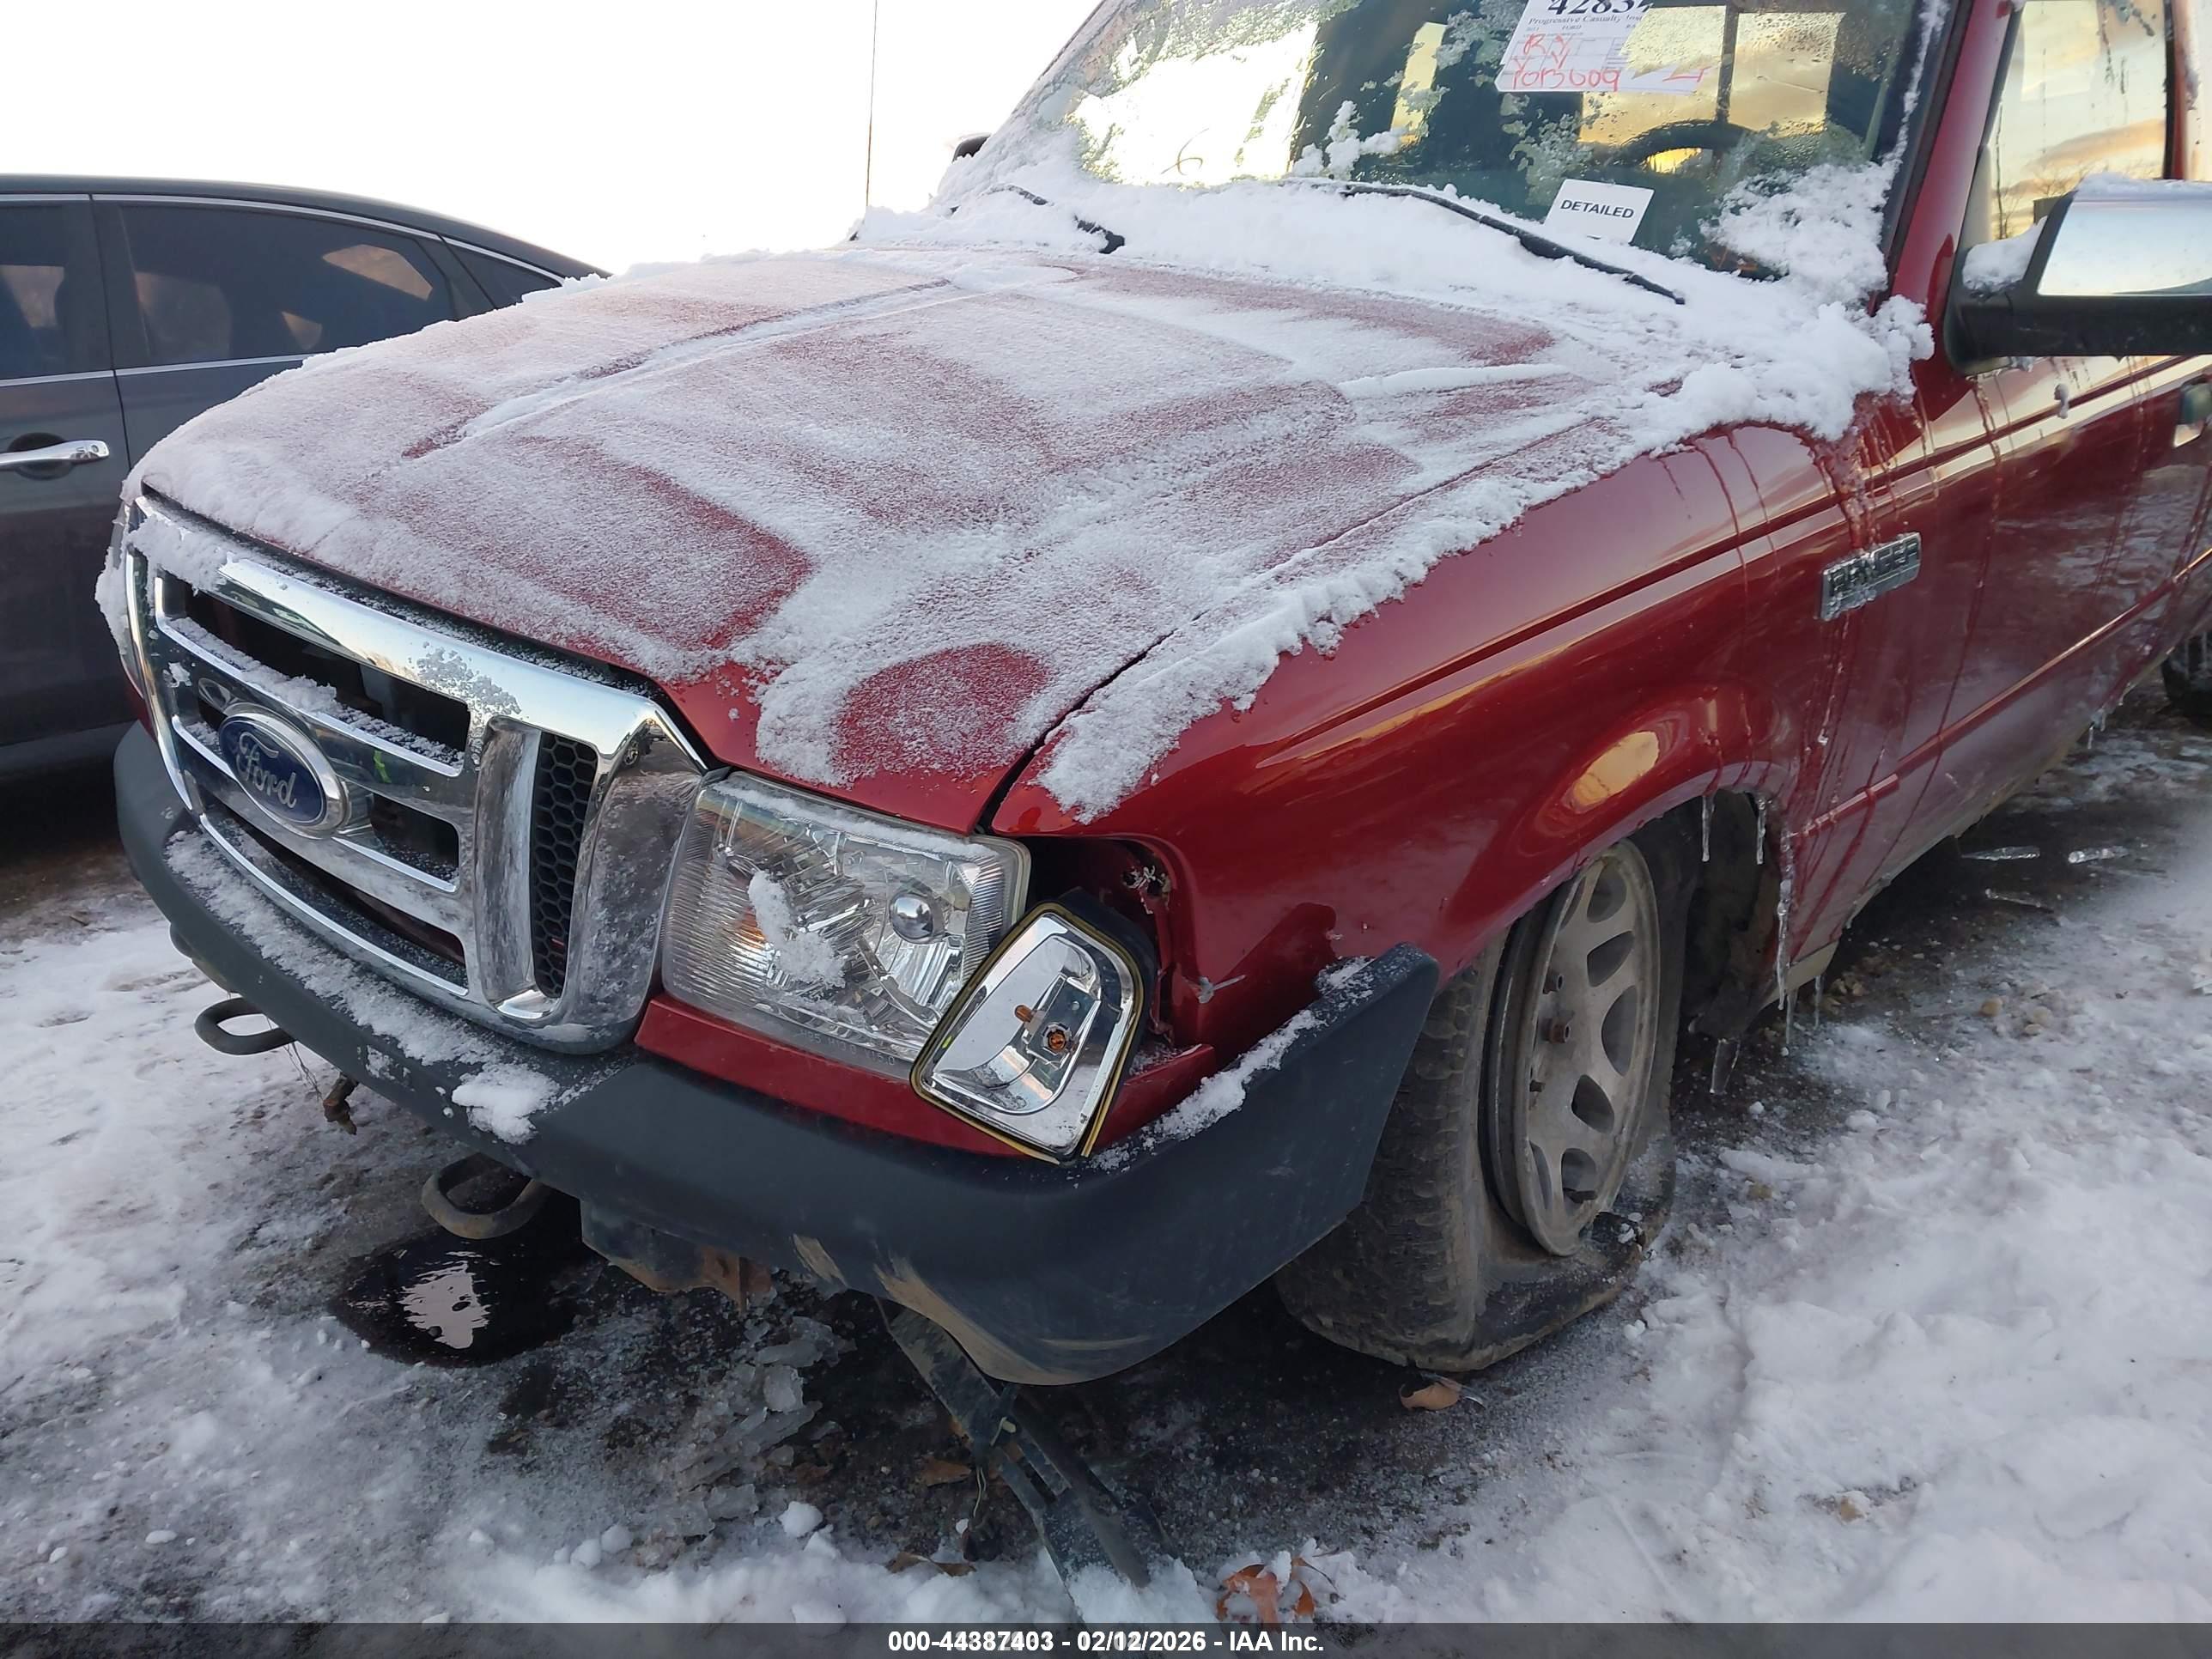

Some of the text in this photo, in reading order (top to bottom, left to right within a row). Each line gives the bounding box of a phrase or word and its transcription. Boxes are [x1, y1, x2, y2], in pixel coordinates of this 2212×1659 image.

[1528, 16, 1580, 26] Progressive
[1582, 15, 1621, 24] Casualty
[1560, 199, 1634, 219] DETAILED
[235, 732, 298, 809] Ford
